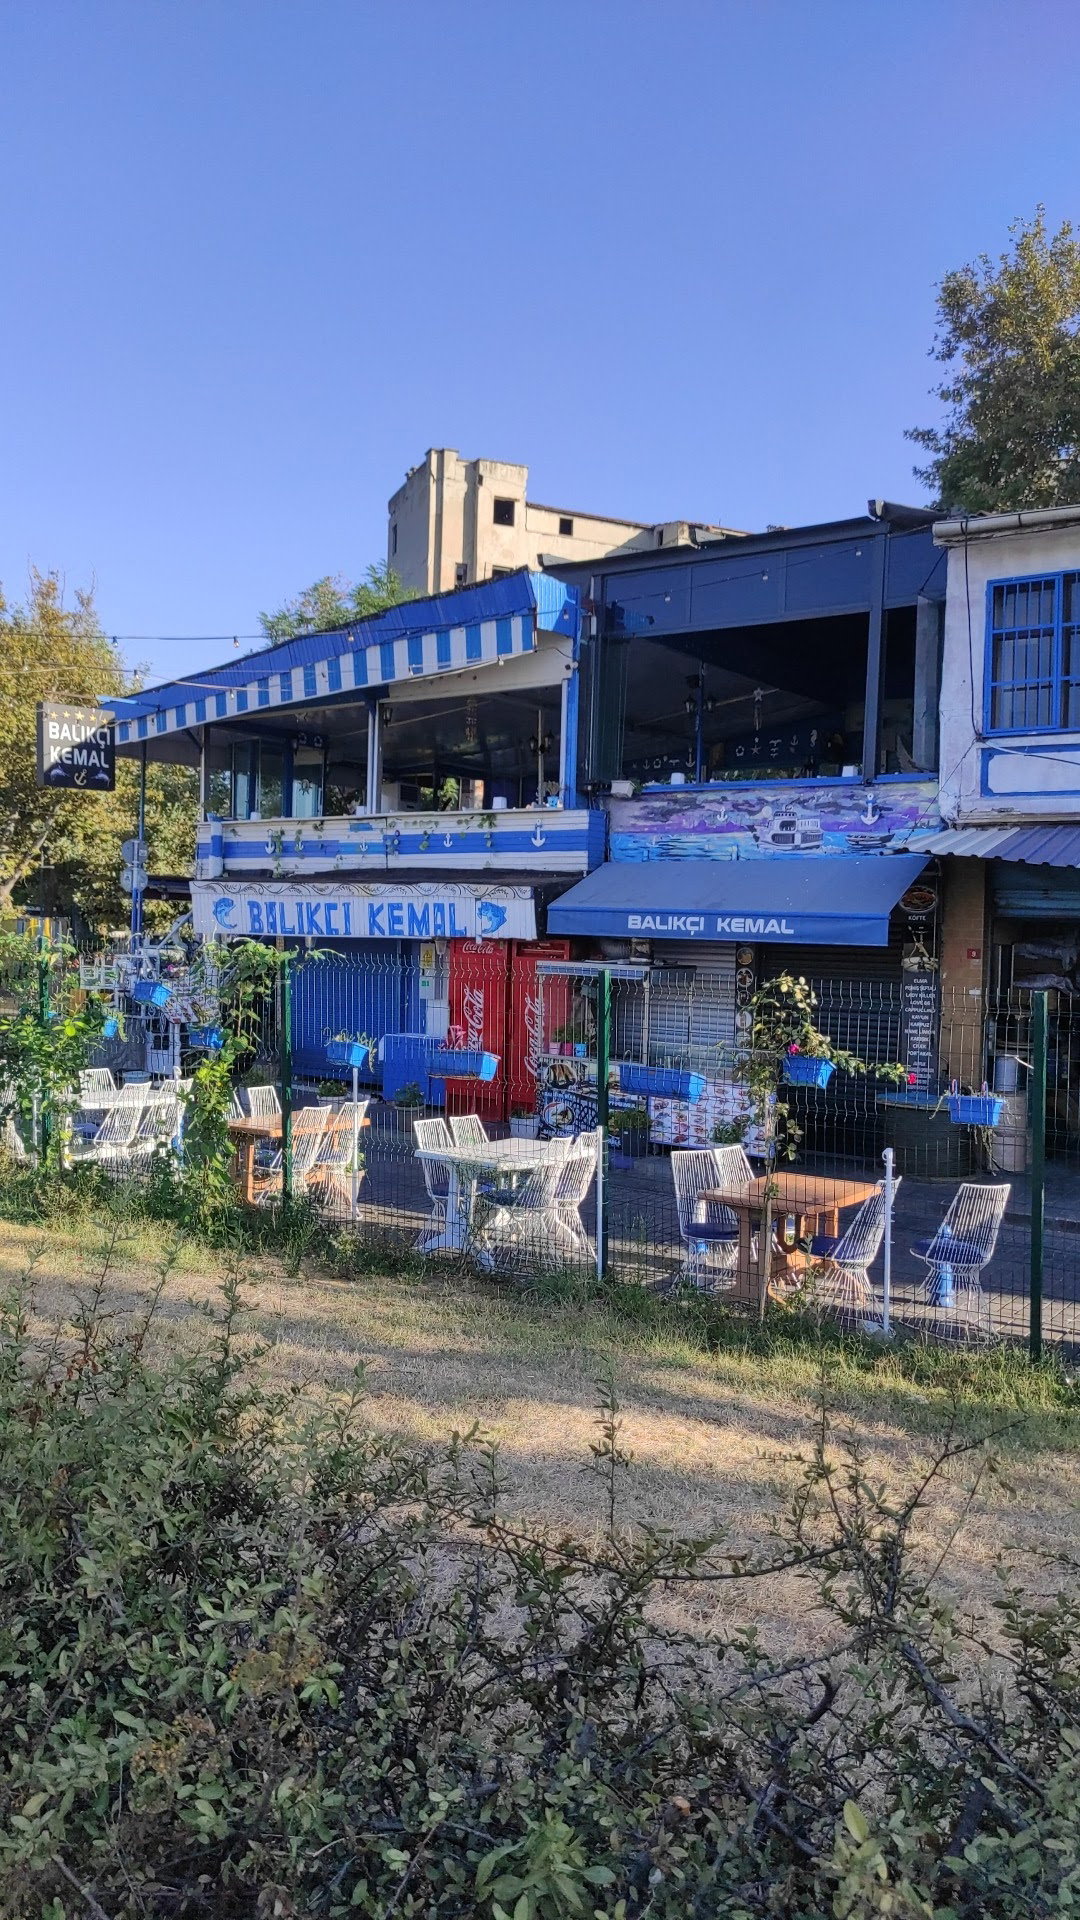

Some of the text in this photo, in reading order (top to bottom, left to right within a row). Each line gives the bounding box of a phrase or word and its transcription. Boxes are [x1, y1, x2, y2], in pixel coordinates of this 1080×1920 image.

[48, 721, 111, 749] BALIKÇI
[50, 745, 110, 769] KEMAL
[368, 902, 468, 937] KEMAL
[627, 915, 795, 936] BALIKÇI KEMAL
